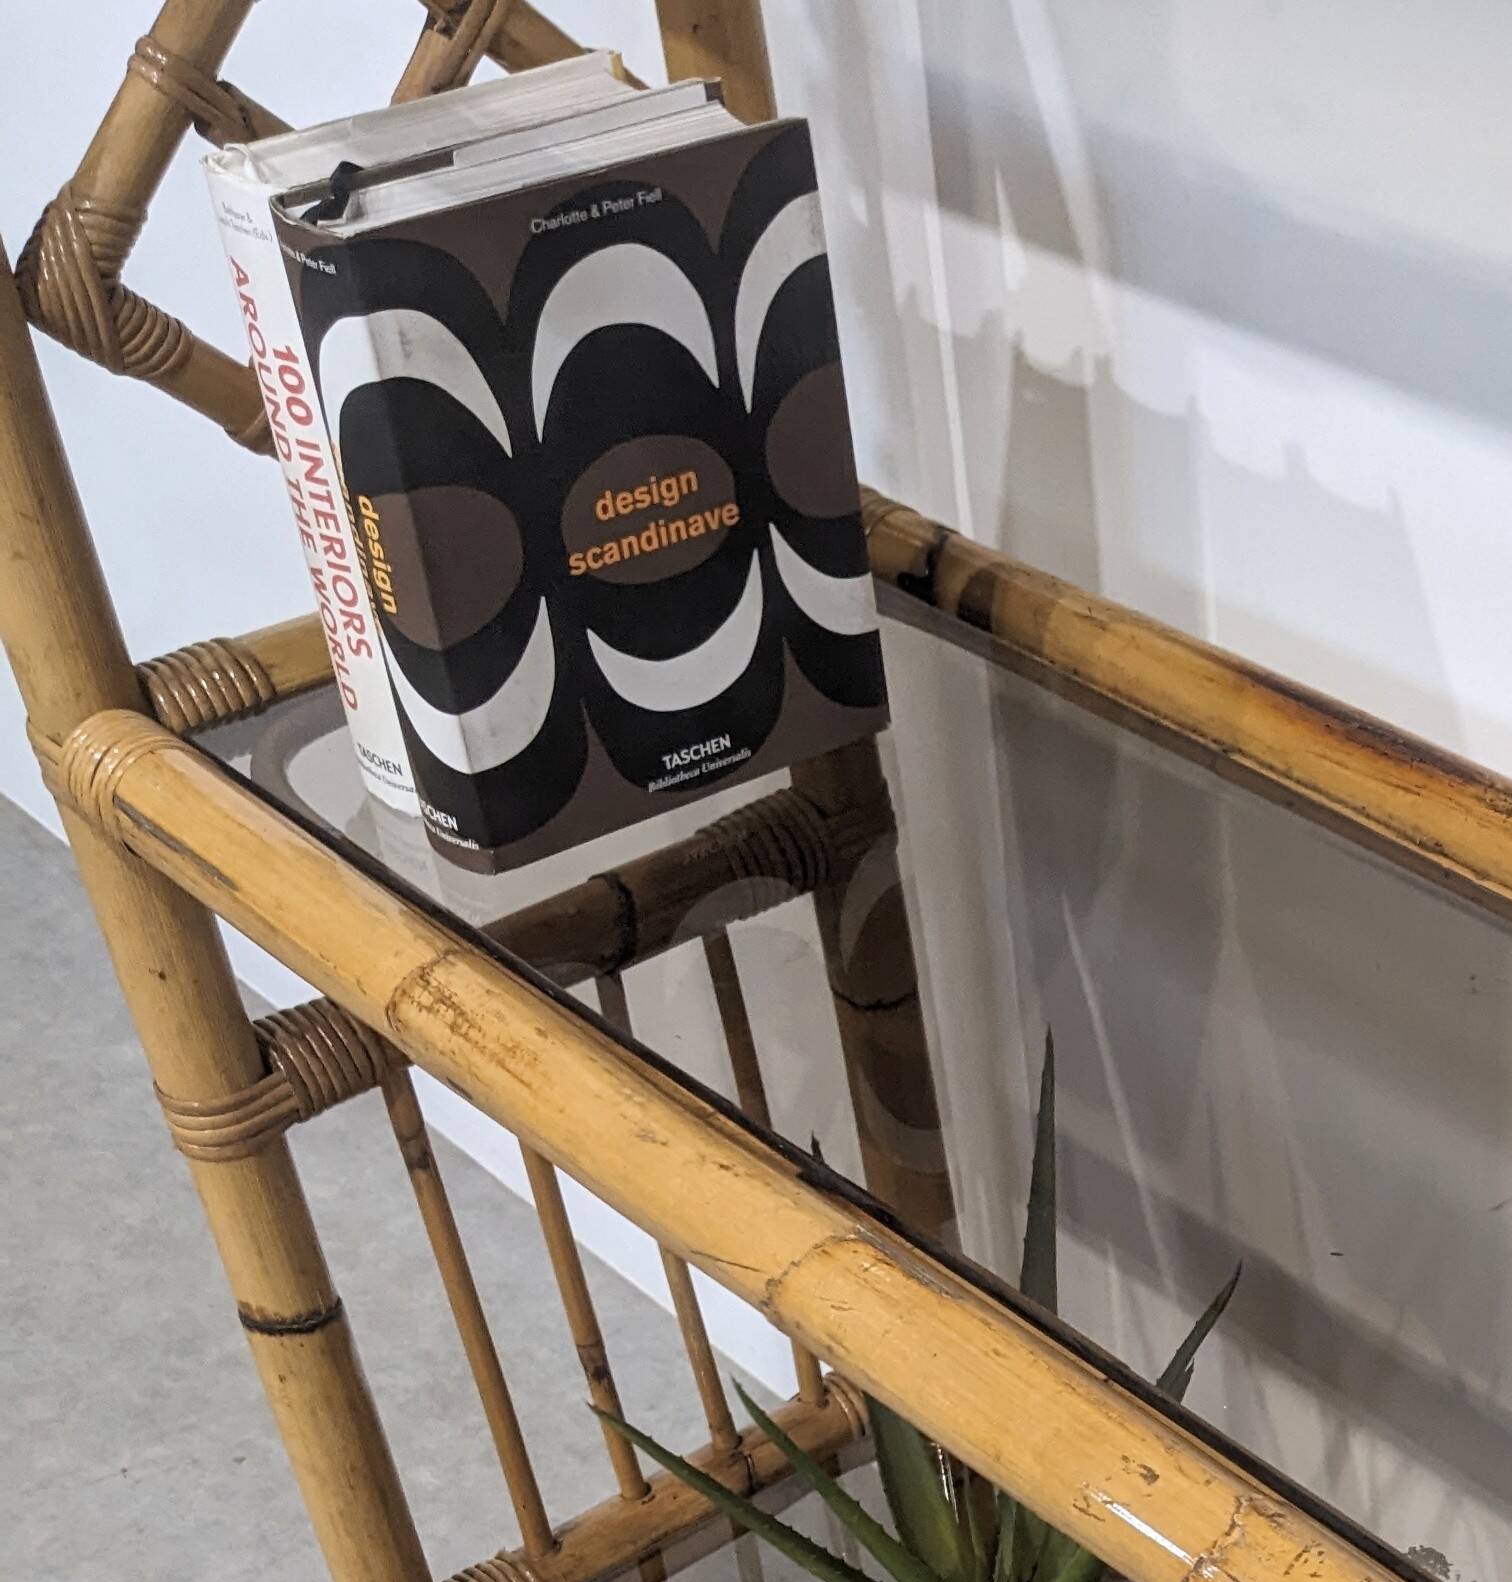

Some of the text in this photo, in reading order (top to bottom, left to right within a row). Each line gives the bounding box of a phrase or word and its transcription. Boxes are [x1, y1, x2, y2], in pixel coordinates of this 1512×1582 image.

[531, 186, 663, 233] Charlotte & Peter Fiell
[228, 254, 294, 463] AROUND
[285, 476, 318, 556] THE
[311, 567, 359, 712] WORLD
[272, 343, 373, 660] 100 INTERIORS
[595, 470, 699, 521] design
[358, 494, 398, 615] design
[568, 502, 741, 576] scandinave
[356, 742, 404, 777] TASCHEN
[661, 733, 732, 770] TASCHEN
